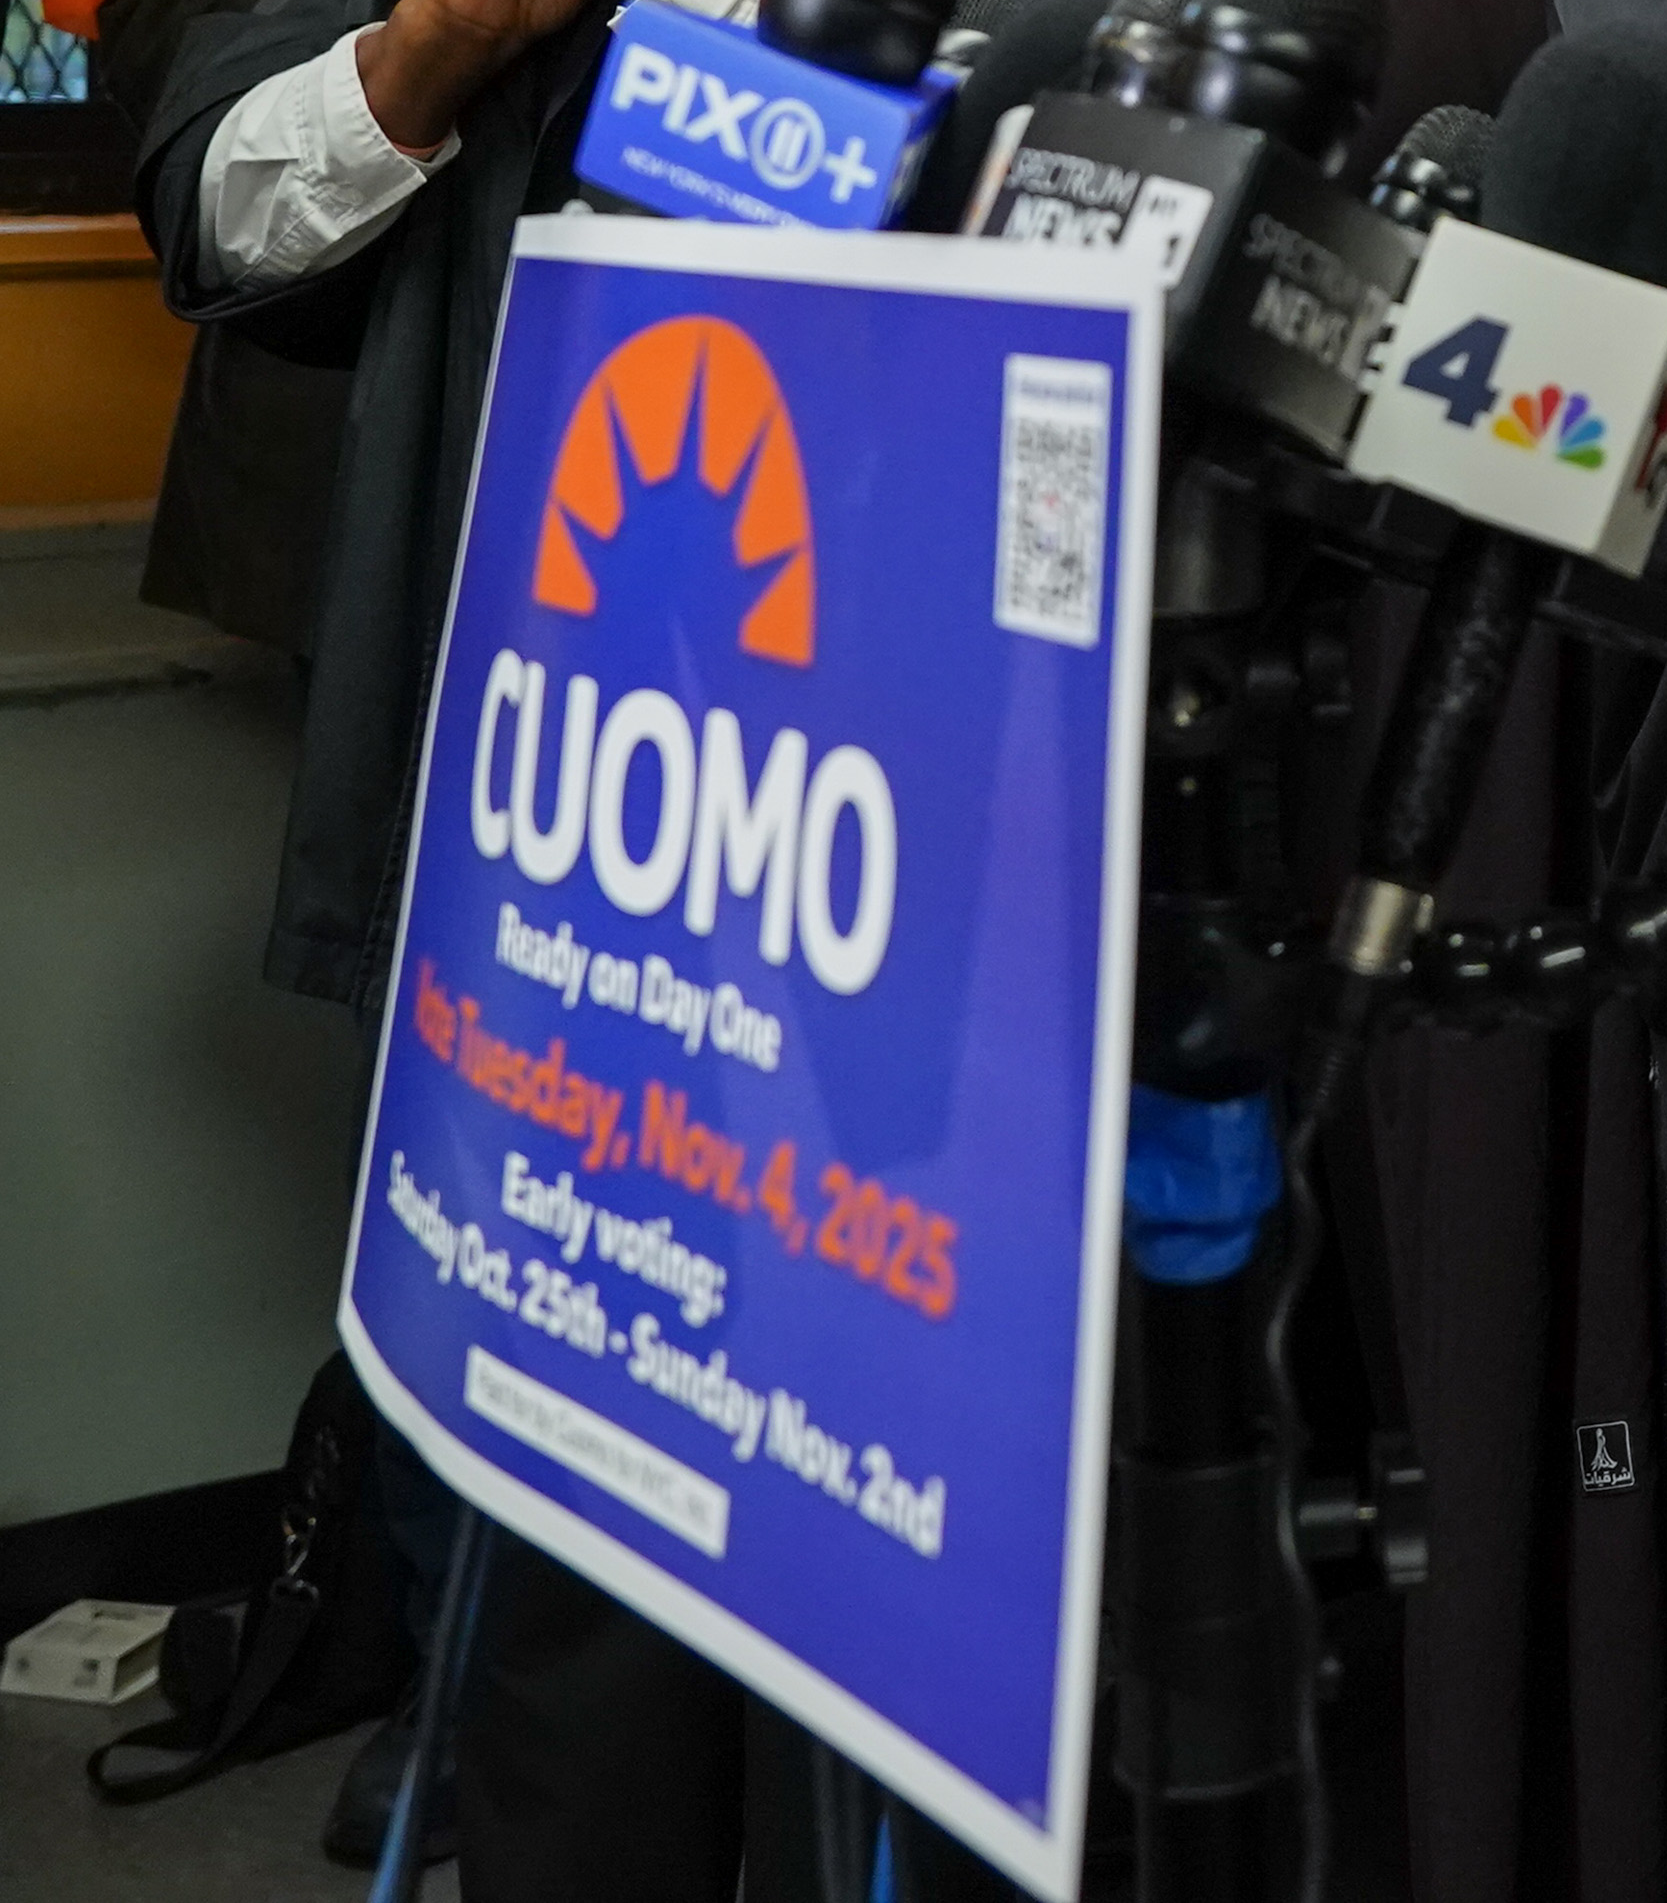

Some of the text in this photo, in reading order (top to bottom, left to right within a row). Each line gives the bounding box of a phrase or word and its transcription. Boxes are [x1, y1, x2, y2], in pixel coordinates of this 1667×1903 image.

[1402, 316, 1510, 427] 4
[470, 648, 898, 995] CUOMO
[496, 902, 782, 1073] Ready on Day One
[456, 997, 630, 1172] Tuesday,
[639, 1079, 752, 1214] Nov.
[757, 1139, 808, 1258] 4,
[816, 1161, 957, 1321] 2025
[502, 1151, 728, 1328] Early voting:
[457, 1222, 518, 1313] Oct.
[518, 1259, 607, 1359] 25th
[626, 1312, 767, 1463] Sunday
[764, 1387, 858, 1507] Nov.
[857, 1443, 946, 1560] 2nd
[1584, 1467, 1632, 1487] شرقيات
